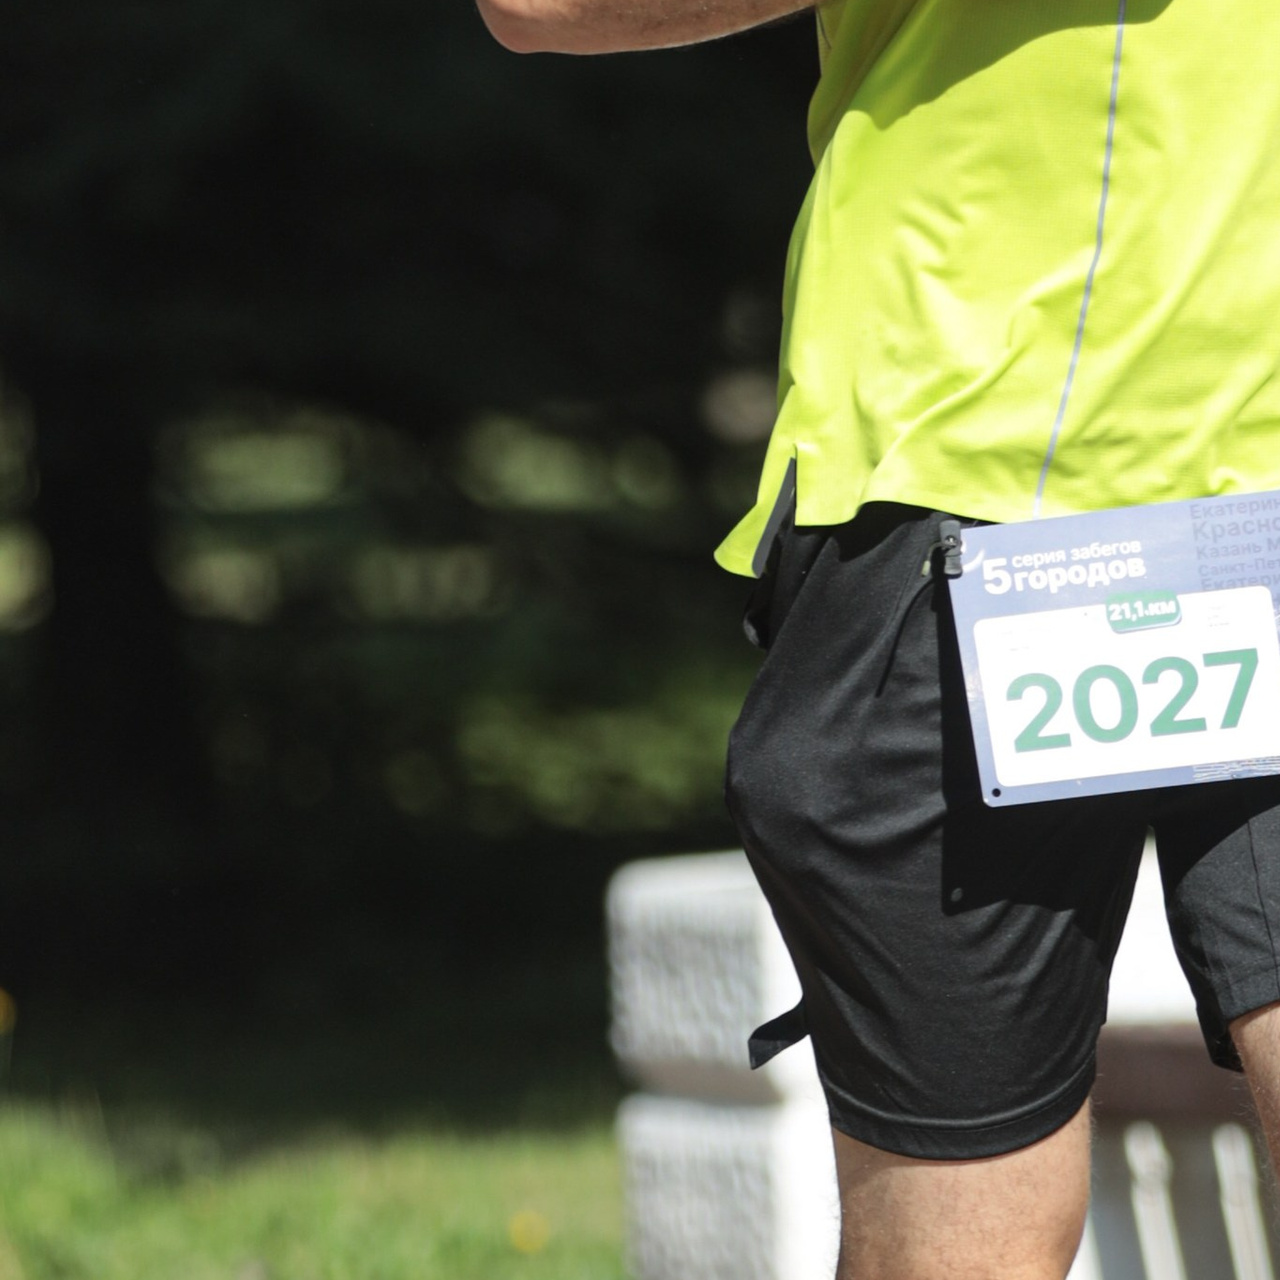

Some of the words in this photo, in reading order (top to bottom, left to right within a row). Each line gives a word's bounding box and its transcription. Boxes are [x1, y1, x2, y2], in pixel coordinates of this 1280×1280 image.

[1011, 549, 1067, 569] серия
[1070, 540, 1142, 561] забегов
[1196, 543, 1263, 560] Казань
[1006, 647, 1260, 754] 2027
